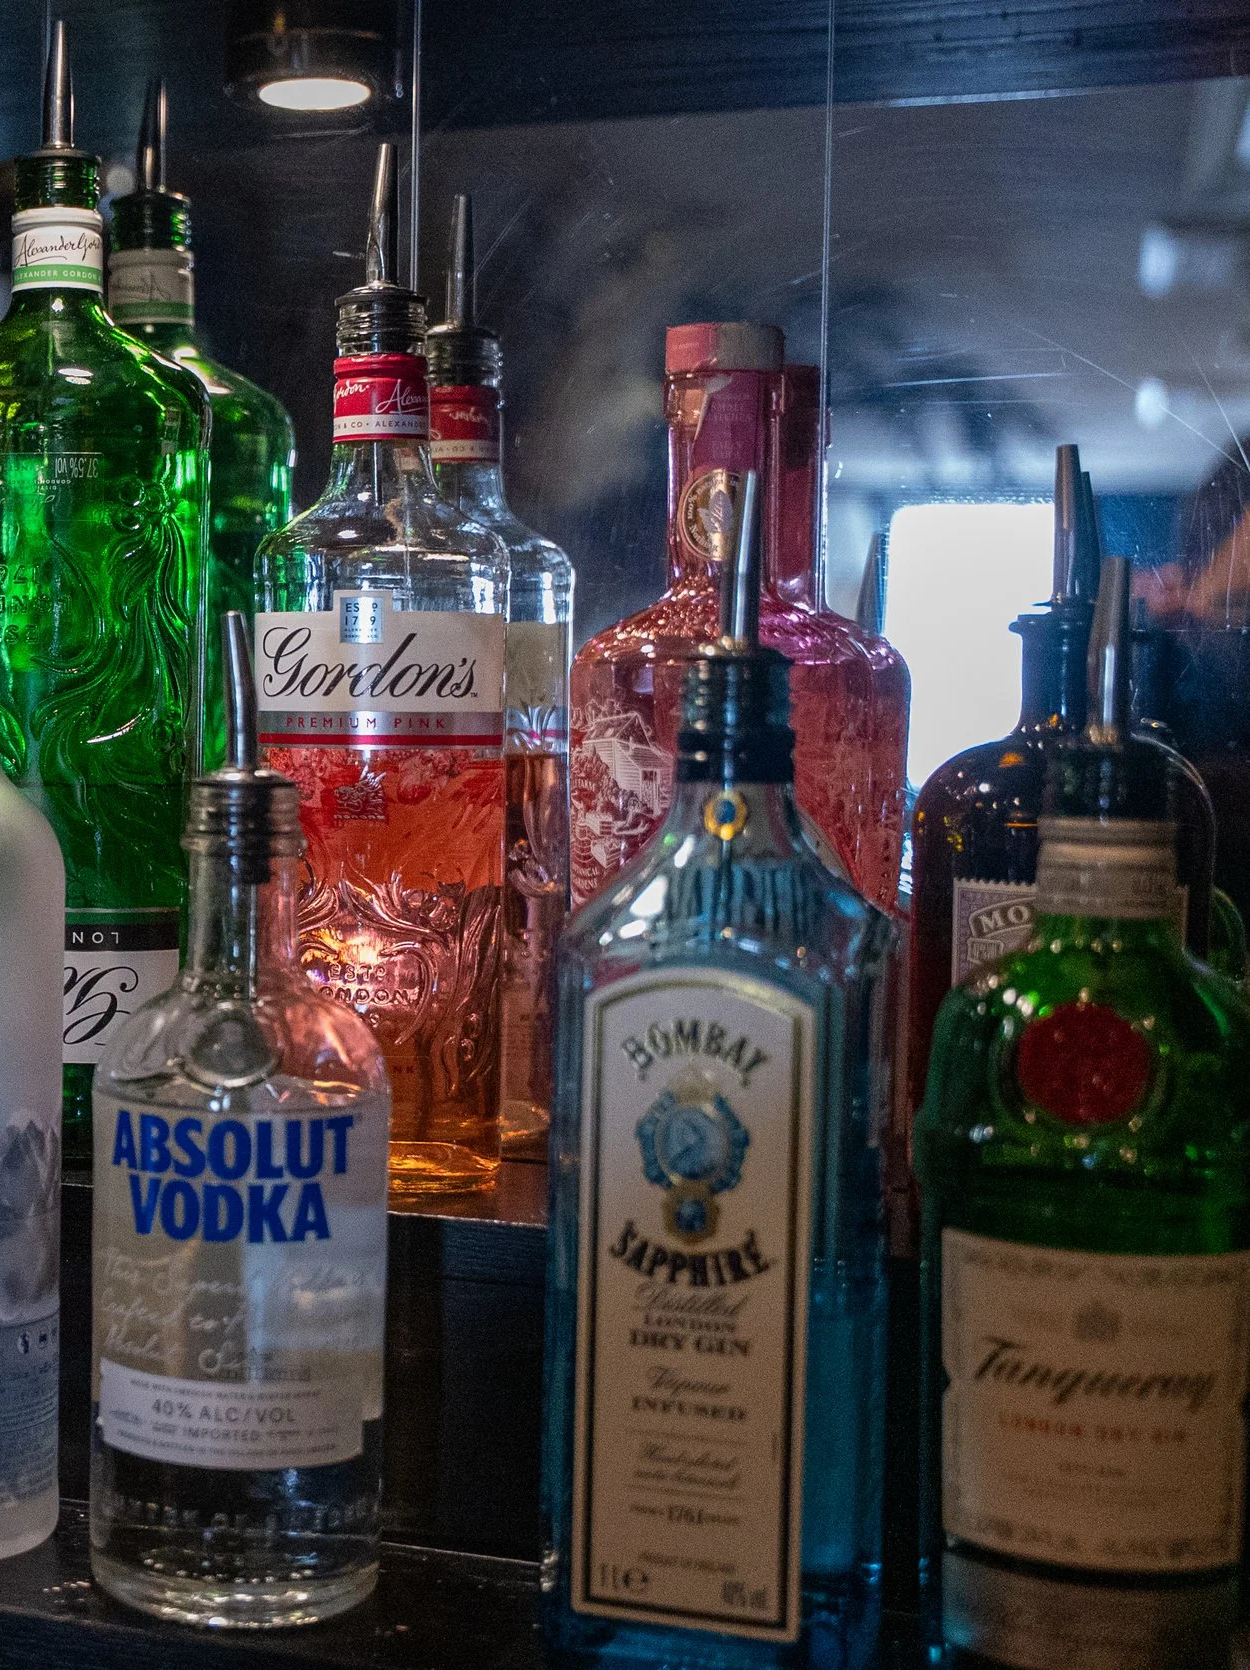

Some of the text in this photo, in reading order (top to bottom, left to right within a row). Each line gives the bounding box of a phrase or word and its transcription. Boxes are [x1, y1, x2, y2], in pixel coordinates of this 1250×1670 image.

[62, 270, 97, 280] GORDON
[55, 457, 68, 478] vol
[345, 602, 378, 613] ESD
[345, 615, 376, 626] 179
[262, 627, 477, 698] Gordon's
[285, 717, 447, 729] PREMIUM PINK
[621, 1017, 767, 1088] BOMBAY
[112, 1110, 355, 1180] ABSOLUT
[128, 1174, 331, 1243] VODKA
[628, 1329, 751, 1359] DRY GIN
[974, 1334, 1217, 1413] Tanqueray
[150, 1398, 192, 1419] 40%
[198, 1406, 297, 1424] ALC/VOL
[631, 1397, 748, 1422] INFUSED
[182, 1427, 260, 1441] IMPORTED
